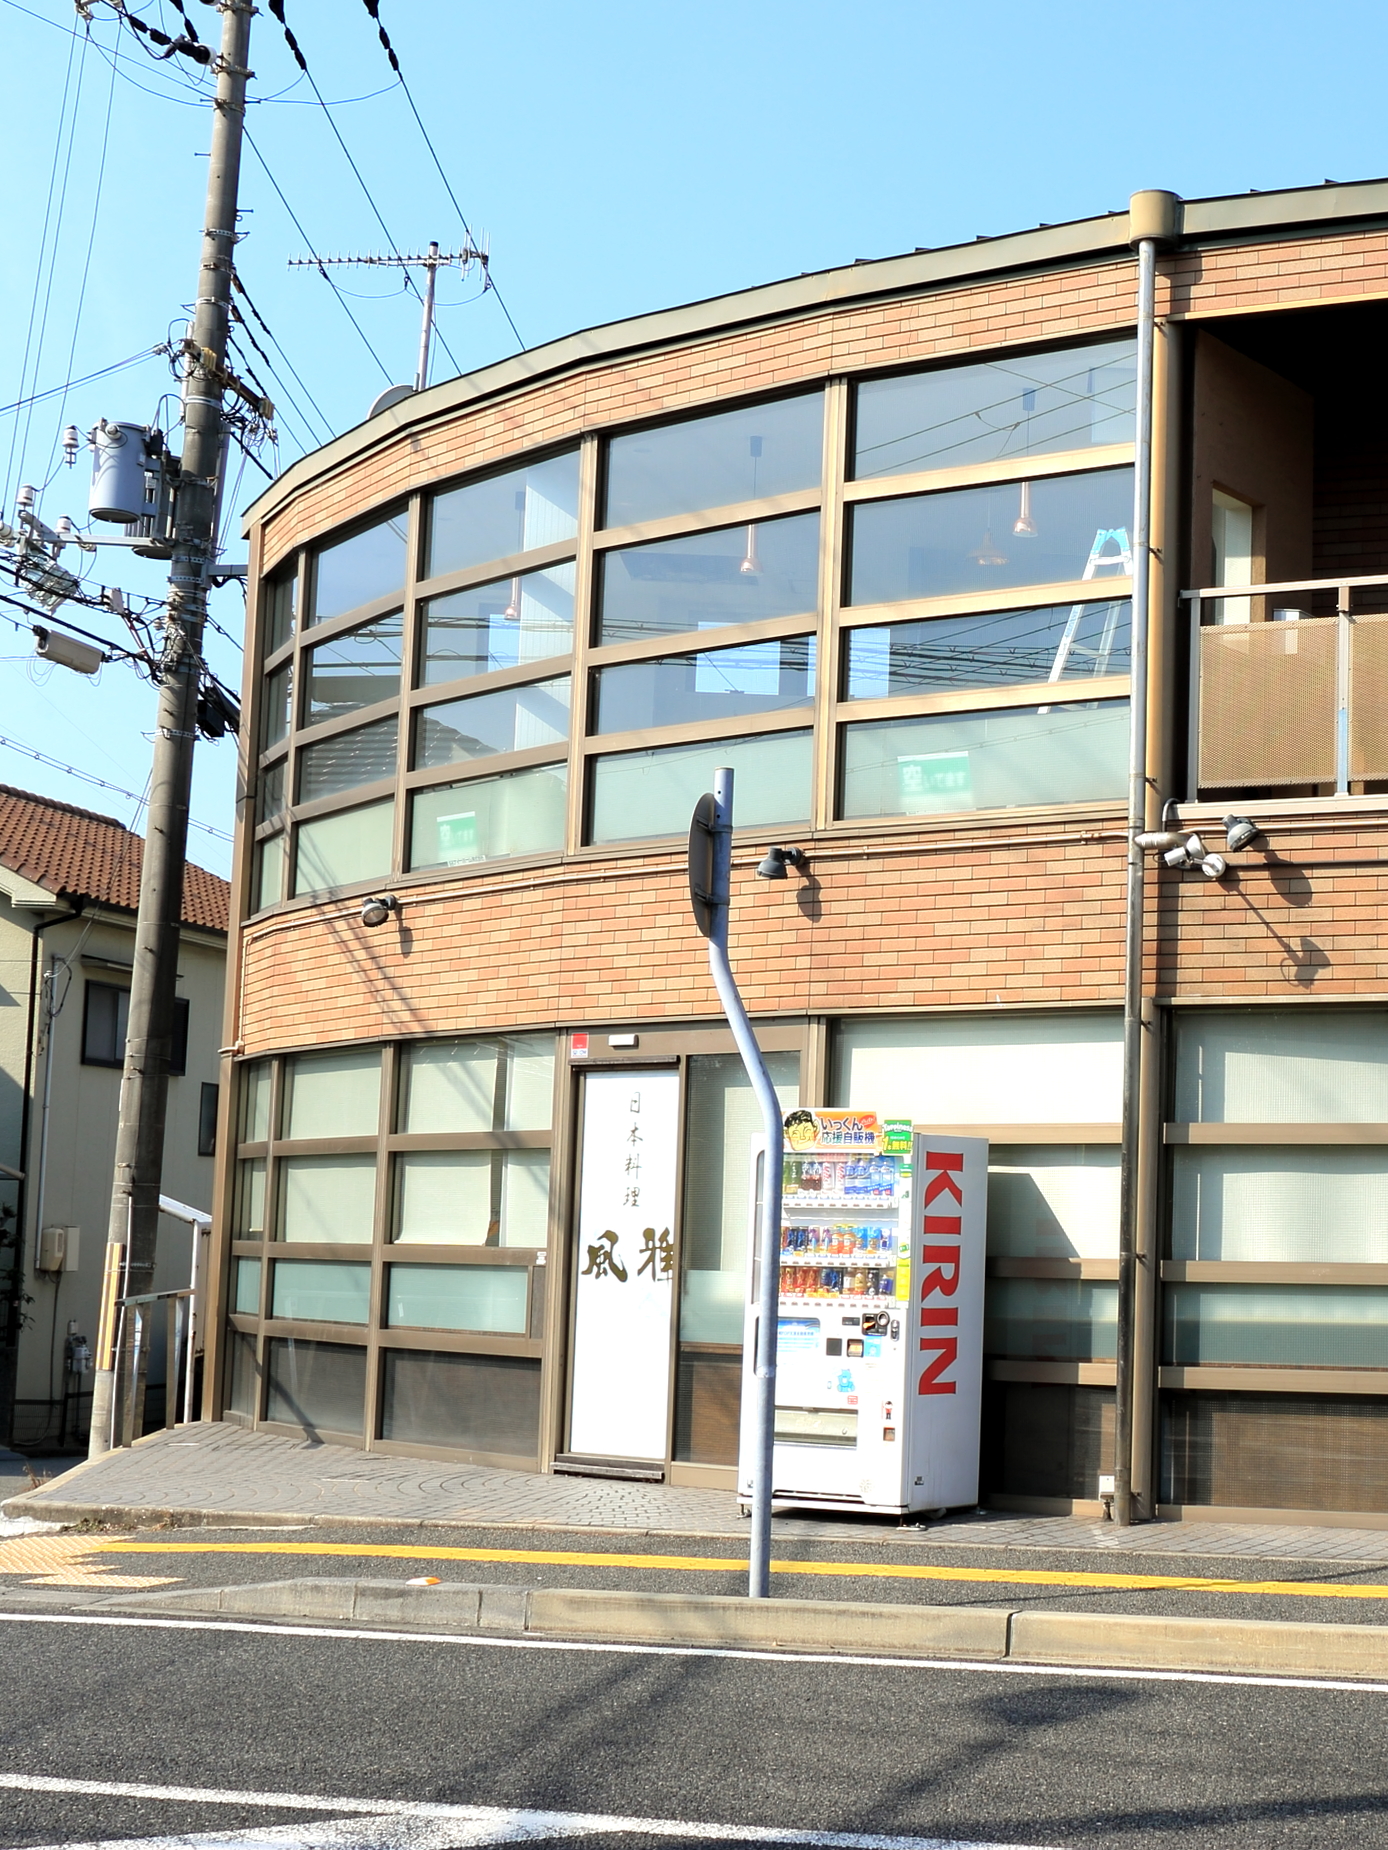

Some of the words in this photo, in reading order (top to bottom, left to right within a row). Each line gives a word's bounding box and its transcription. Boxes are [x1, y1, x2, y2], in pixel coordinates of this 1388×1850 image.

[622, 1091, 643, 1208] 日本料理
[820, 1117, 864, 1131] いっくん
[821, 1131, 875, 1144] 応援自販機
[581, 1226, 674, 1288] 風雅
[917, 1150, 964, 1396] KIRIN
